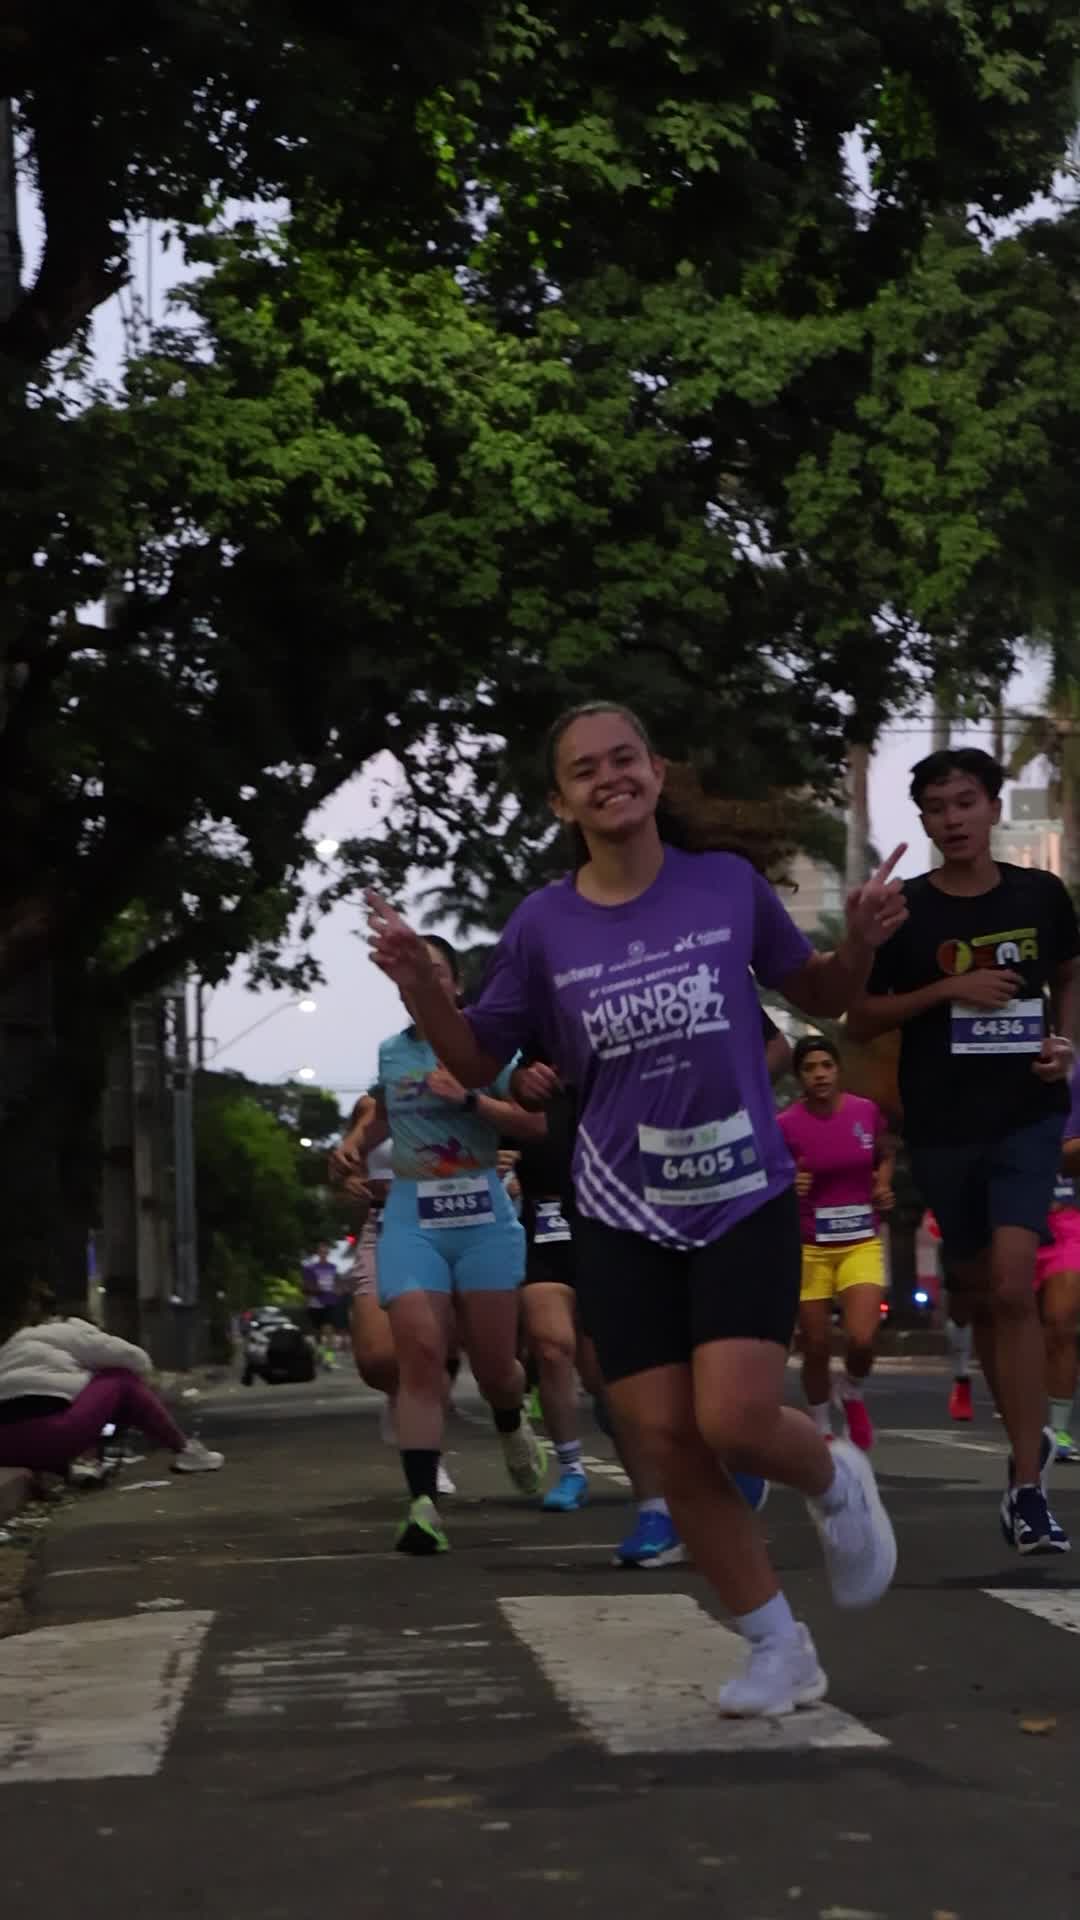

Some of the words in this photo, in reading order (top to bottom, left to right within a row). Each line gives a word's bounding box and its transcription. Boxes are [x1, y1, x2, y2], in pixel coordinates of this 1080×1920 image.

[581, 975, 703, 1027] MUNDO
[972, 1020, 1025, 1036] 6436
[662, 1147, 735, 1182] 6405
[432, 1194, 478, 1212] 5445
